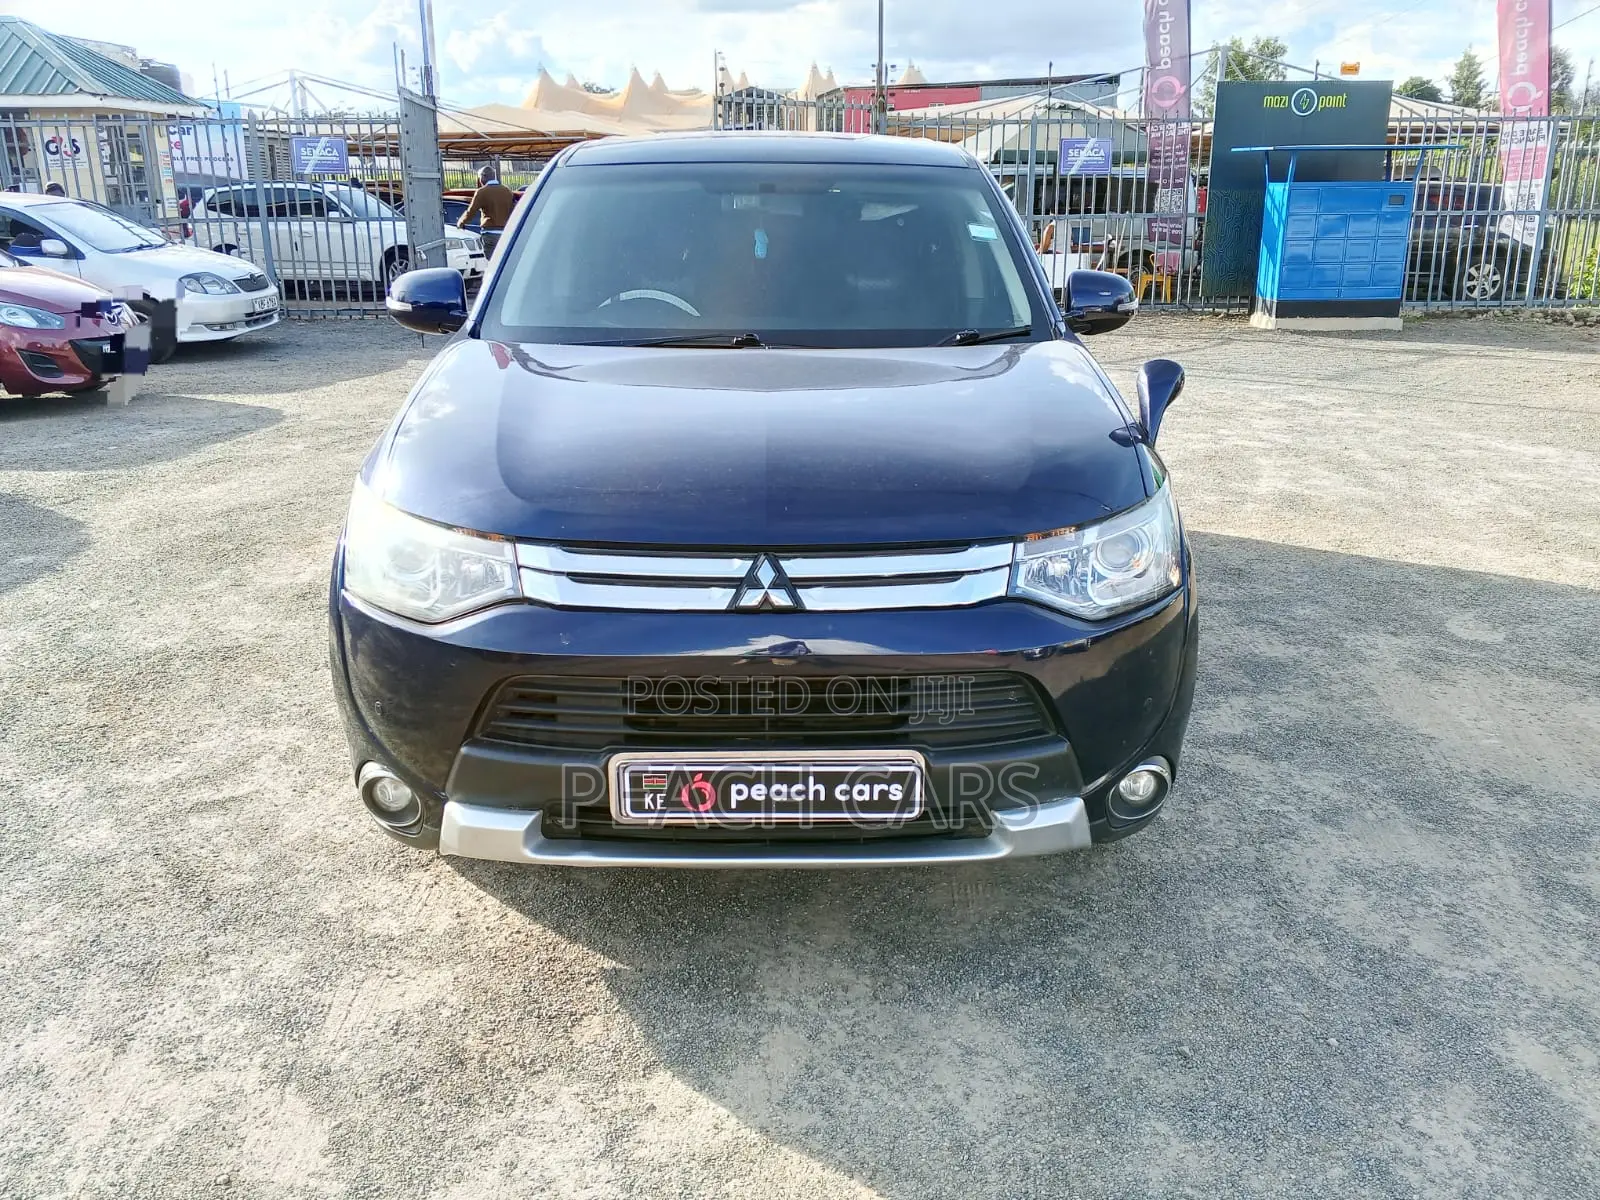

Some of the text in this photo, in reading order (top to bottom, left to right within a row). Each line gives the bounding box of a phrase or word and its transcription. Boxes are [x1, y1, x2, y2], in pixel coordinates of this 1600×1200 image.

[1263, 93, 1347, 111] mozi point
[300, 147, 339, 157] SEACA
[1068, 147, 1105, 157] SEACA
[730, 776, 903, 809] peach cars
[644, 793, 666, 809] KE
